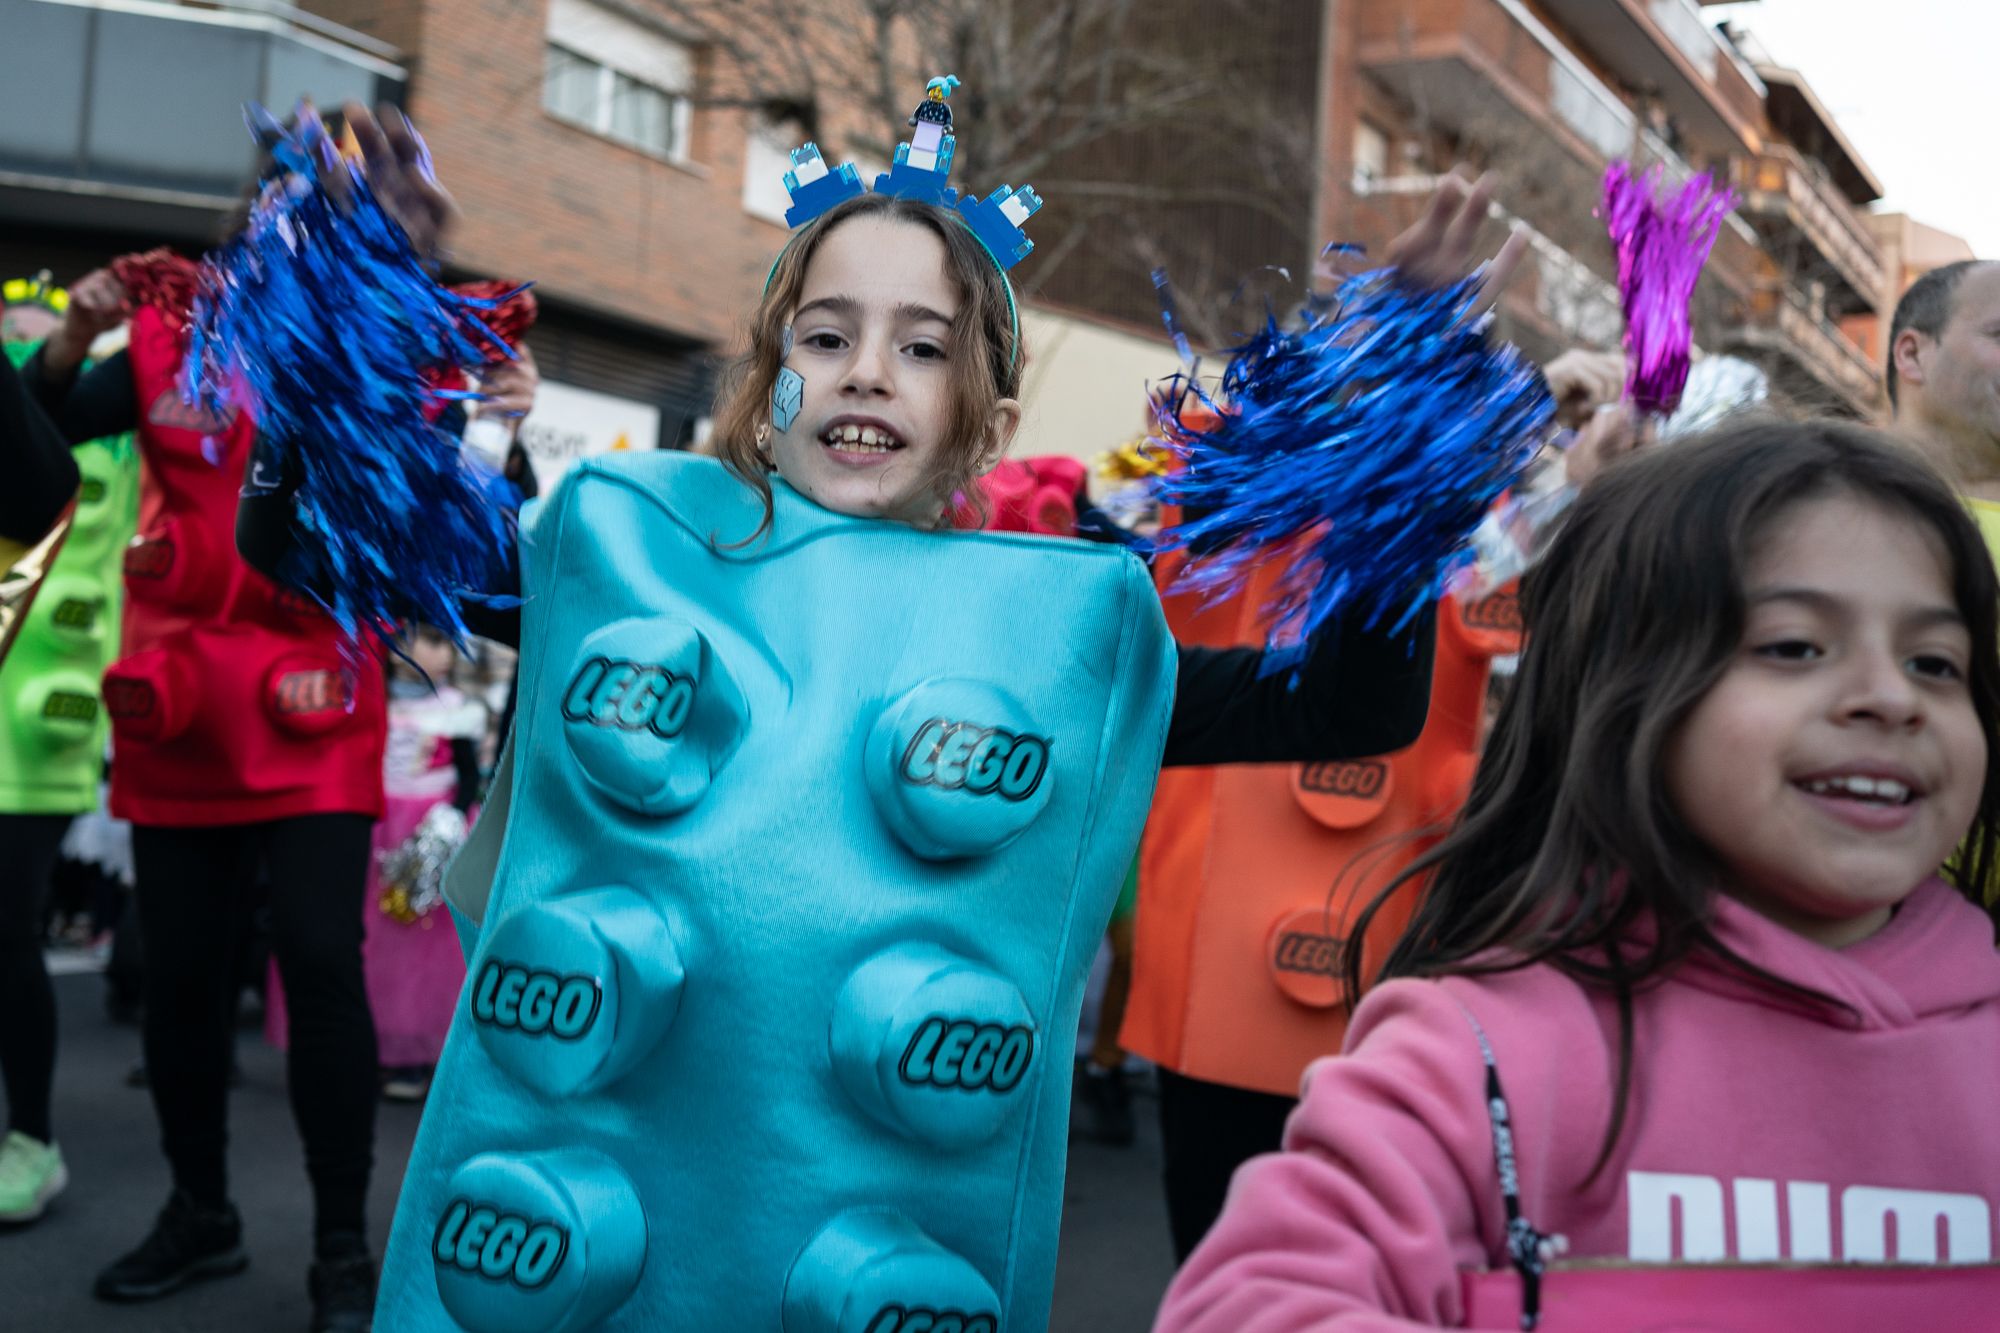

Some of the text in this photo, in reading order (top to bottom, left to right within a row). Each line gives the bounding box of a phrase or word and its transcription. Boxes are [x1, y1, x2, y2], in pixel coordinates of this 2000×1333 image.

[1462, 592, 1522, 632] LEG
[562, 656, 697, 740] LEGO
[901, 717, 1049, 803] LEGO
[1300, 758, 1387, 800] LEGO
[471, 958, 602, 1040] LEGO
[899, 1016, 1034, 1093] LEGO
[431, 1197, 569, 1289] LEGO
